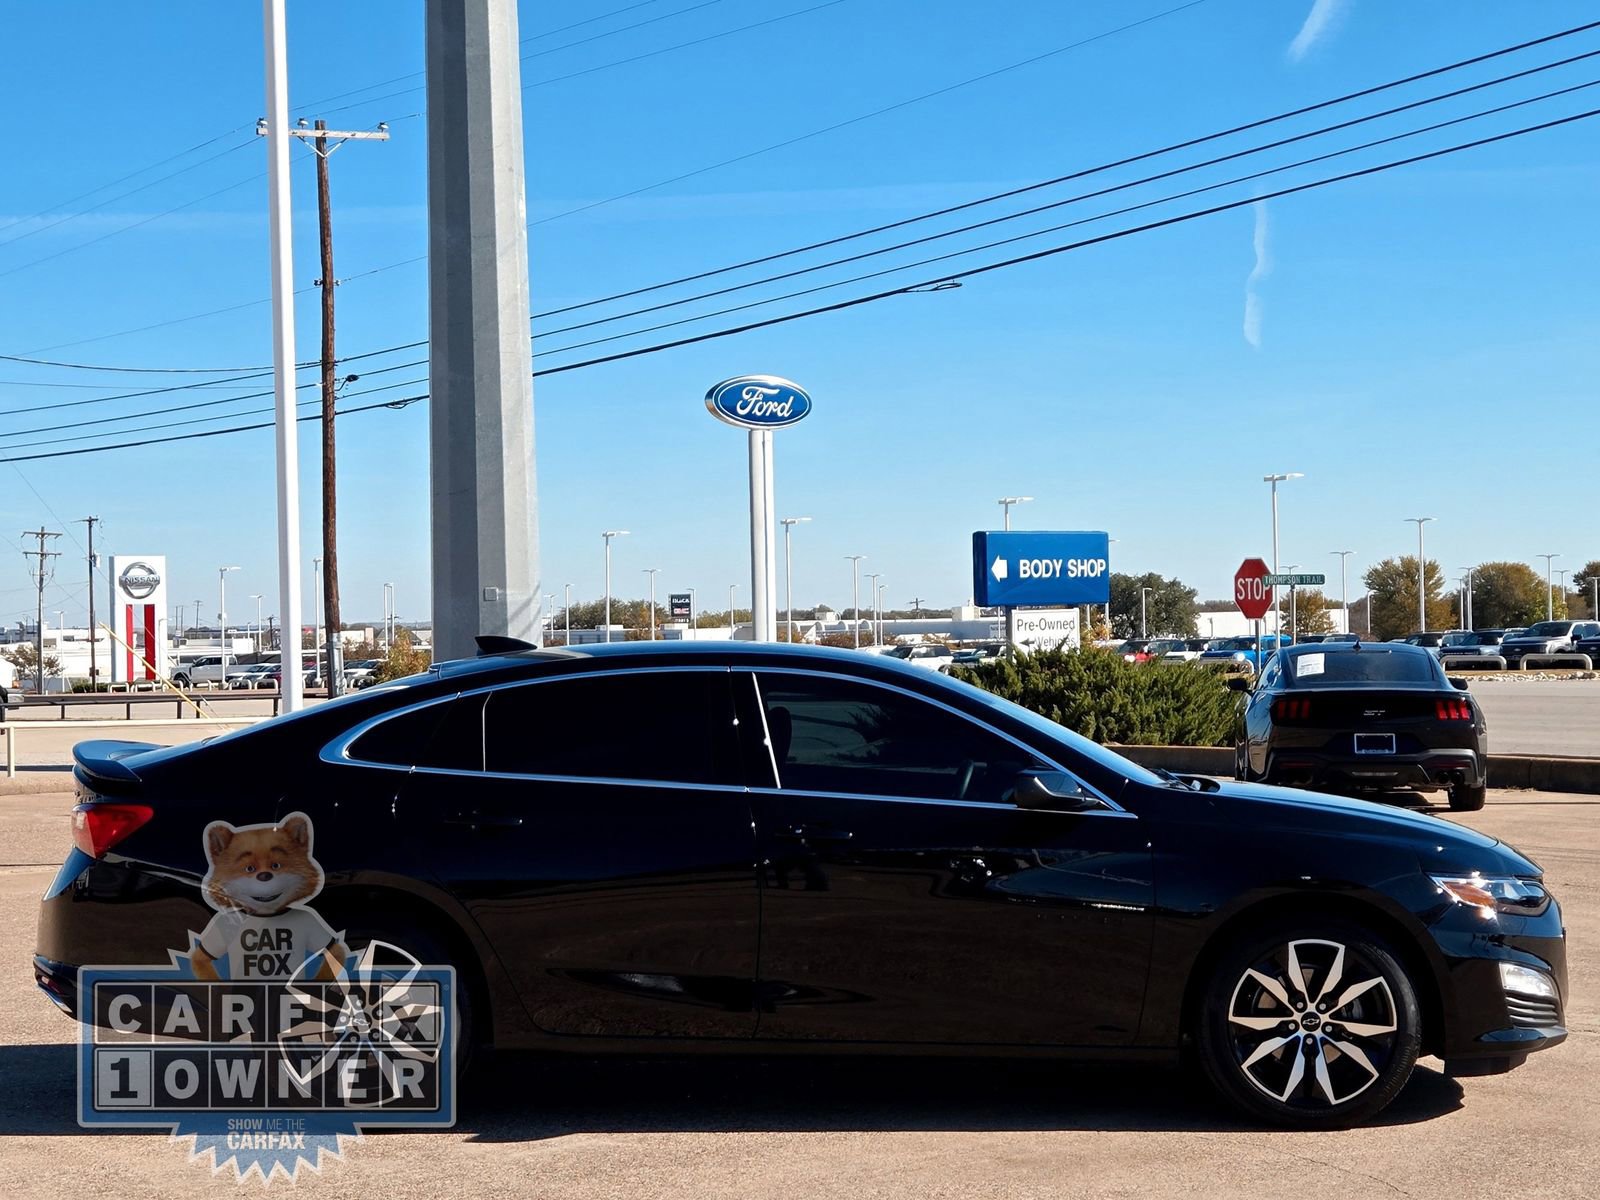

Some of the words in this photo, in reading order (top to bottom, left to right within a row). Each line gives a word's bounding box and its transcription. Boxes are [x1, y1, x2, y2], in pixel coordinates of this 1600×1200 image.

[736, 386, 794, 417] Ford
[1020, 559, 1062, 578] BODY
[1067, 558, 1106, 577] SHOP
[125, 576, 157, 584] NISSAN
[1237, 577, 1271, 600] STOP
[1264, 575, 1301, 585] THOMPSON
[1303, 575, 1324, 584] TRAIL
[1016, 617, 1076, 631] Pre-Owned
